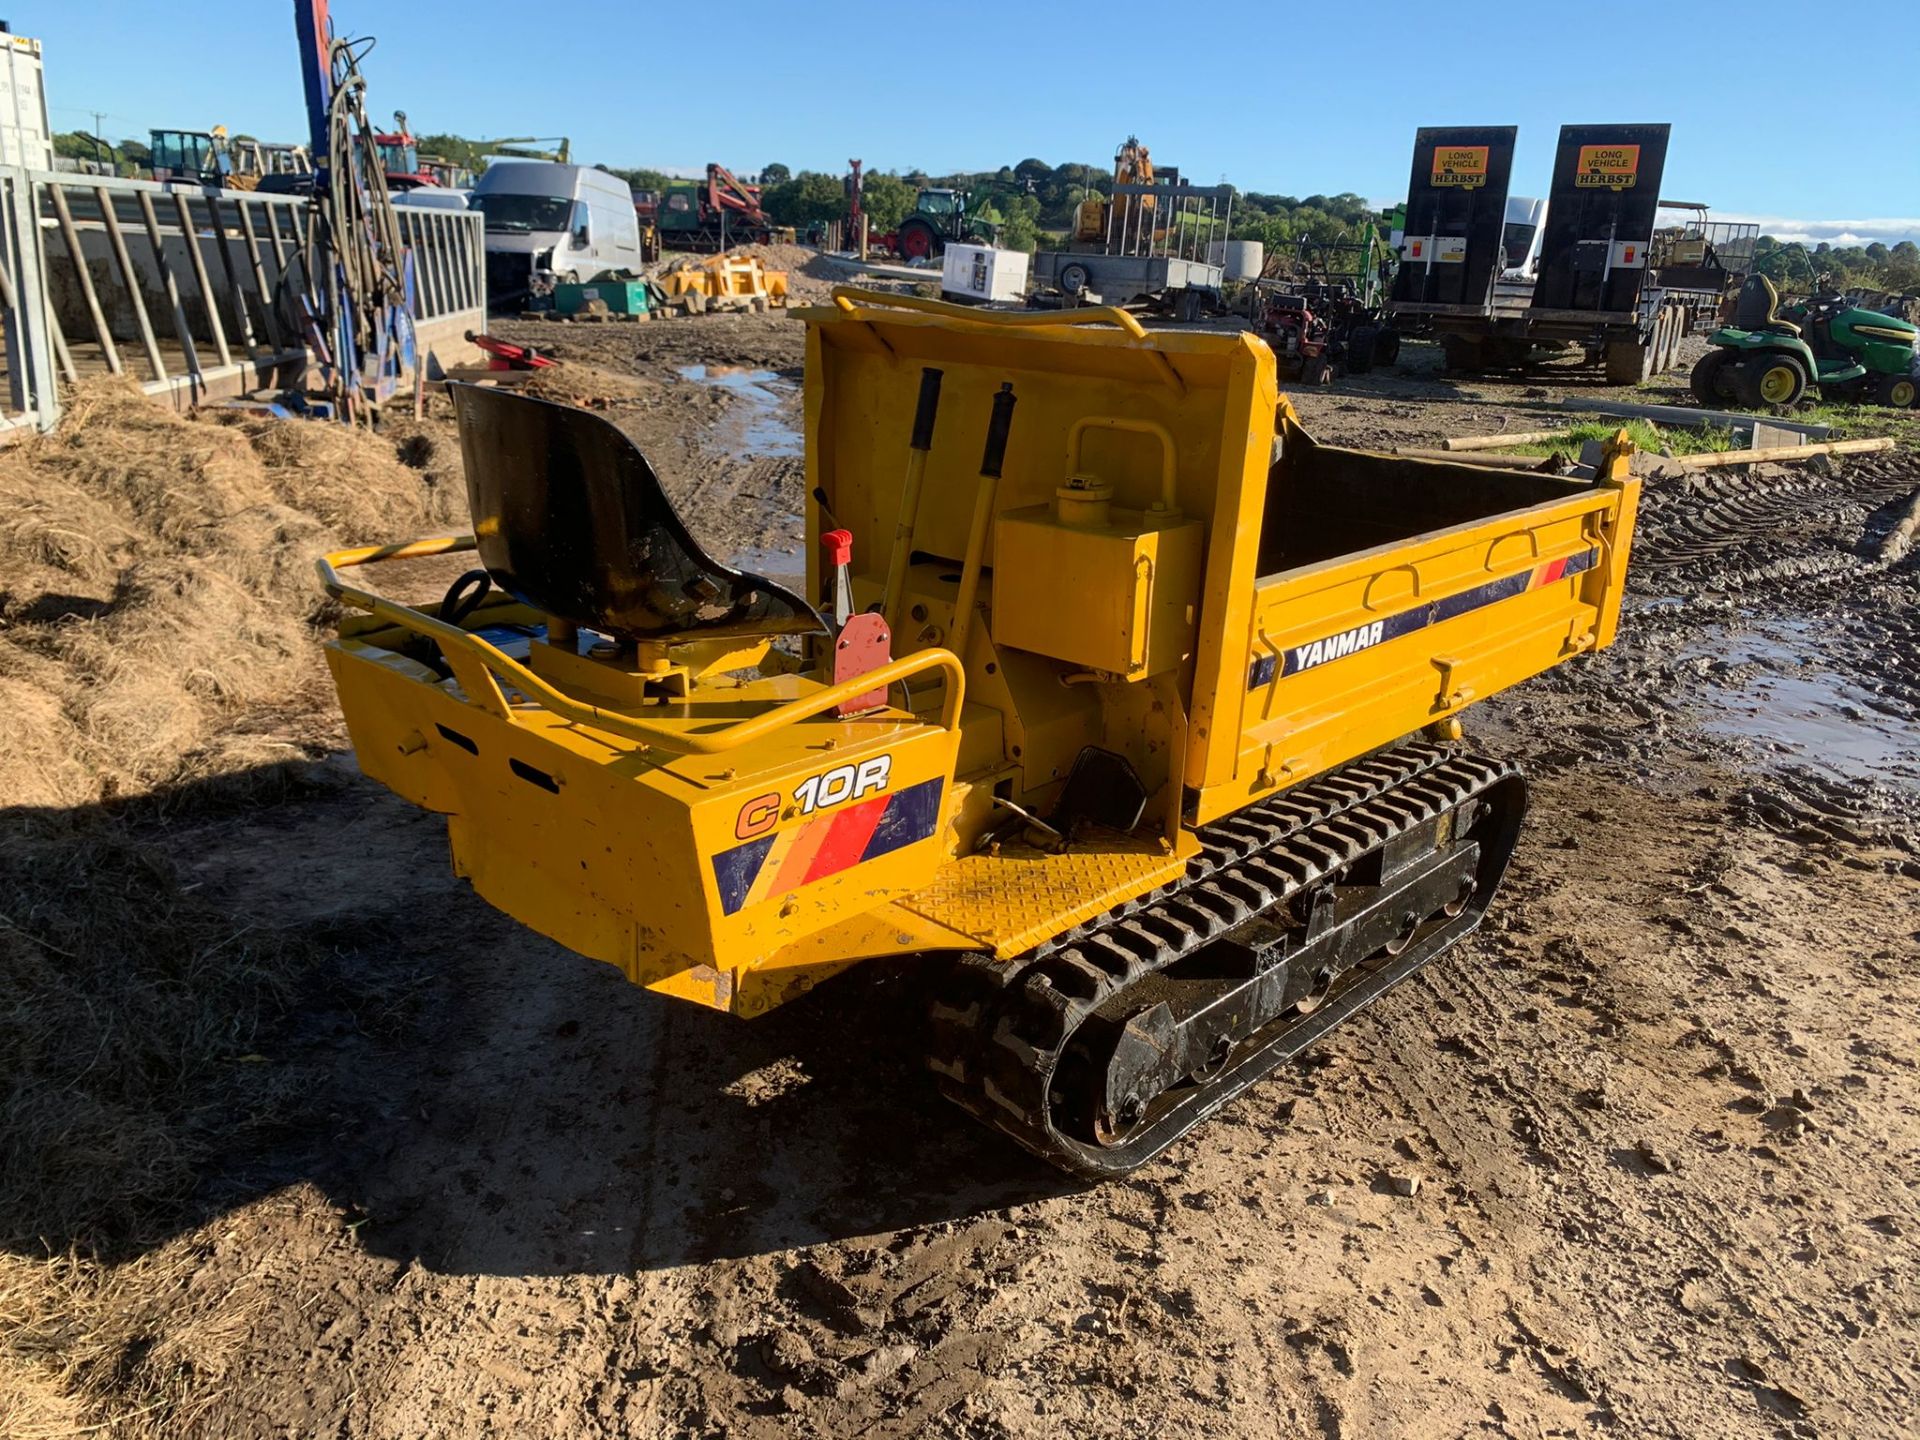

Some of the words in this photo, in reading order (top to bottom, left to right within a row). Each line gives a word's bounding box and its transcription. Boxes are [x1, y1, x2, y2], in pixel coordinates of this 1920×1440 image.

[1448, 152, 1474, 160] LONG
[1594, 150, 1623, 159] LONG
[1441, 160, 1480, 168] VEHICLE
[1587, 159, 1629, 167] VEHICLE
[1435, 174, 1483, 183] HERBST
[1579, 174, 1632, 184] HERBST
[1295, 620, 1384, 671] YANMAR
[734, 791, 781, 840] C
[792, 753, 892, 815] 10R
